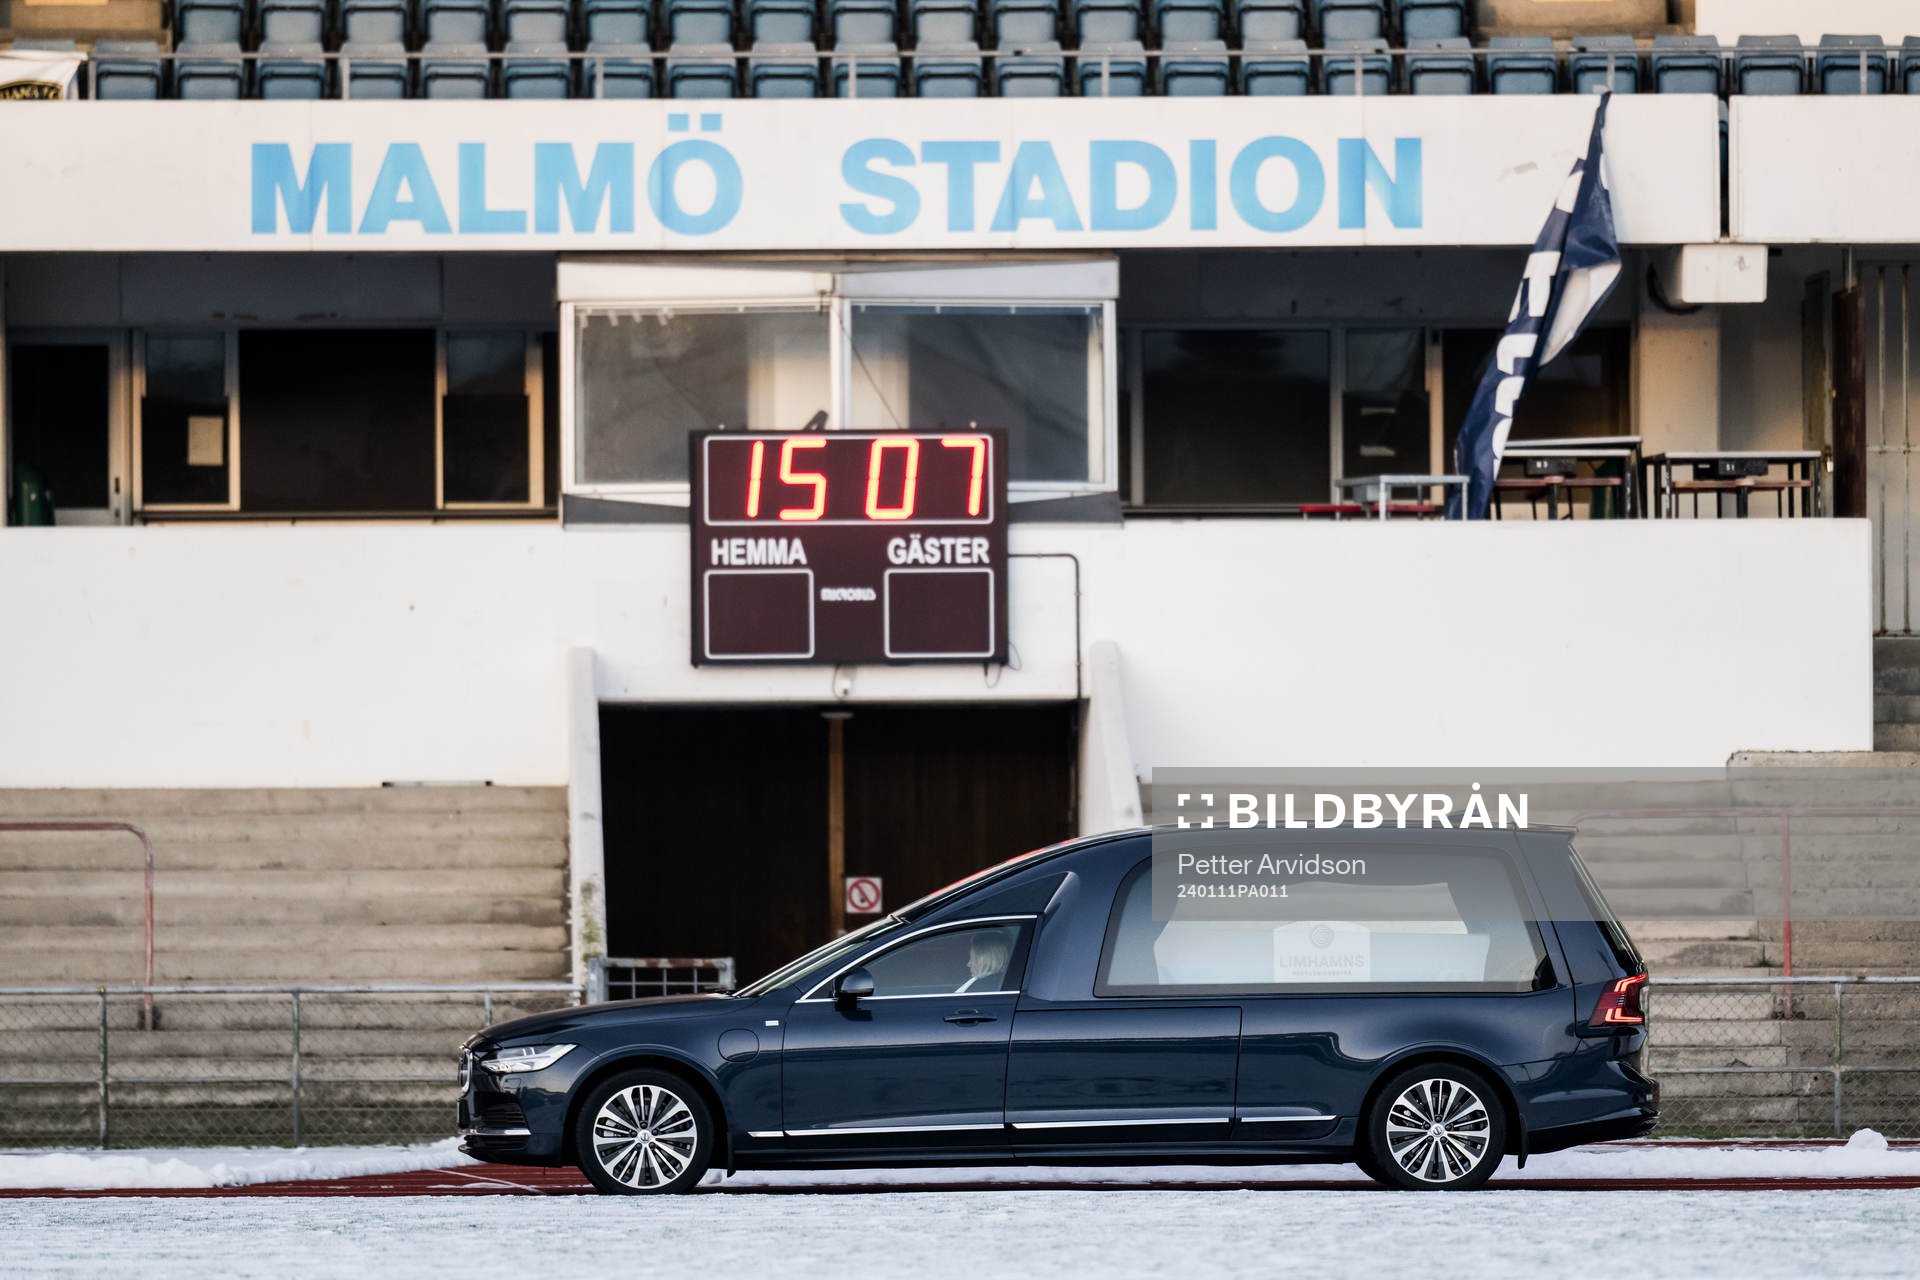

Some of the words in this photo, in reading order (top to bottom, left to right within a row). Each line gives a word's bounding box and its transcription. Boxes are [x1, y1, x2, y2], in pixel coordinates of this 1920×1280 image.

[251, 113, 744, 236] MALMÖ
[839, 135, 1423, 235] STADION
[745, 436, 827, 521] 15
[864, 435, 986, 520] 07
[711, 538, 808, 565] HEMMA
[887, 533, 990, 564] GÄSTER
[1279, 954, 1365, 968] LIMHAMNS
